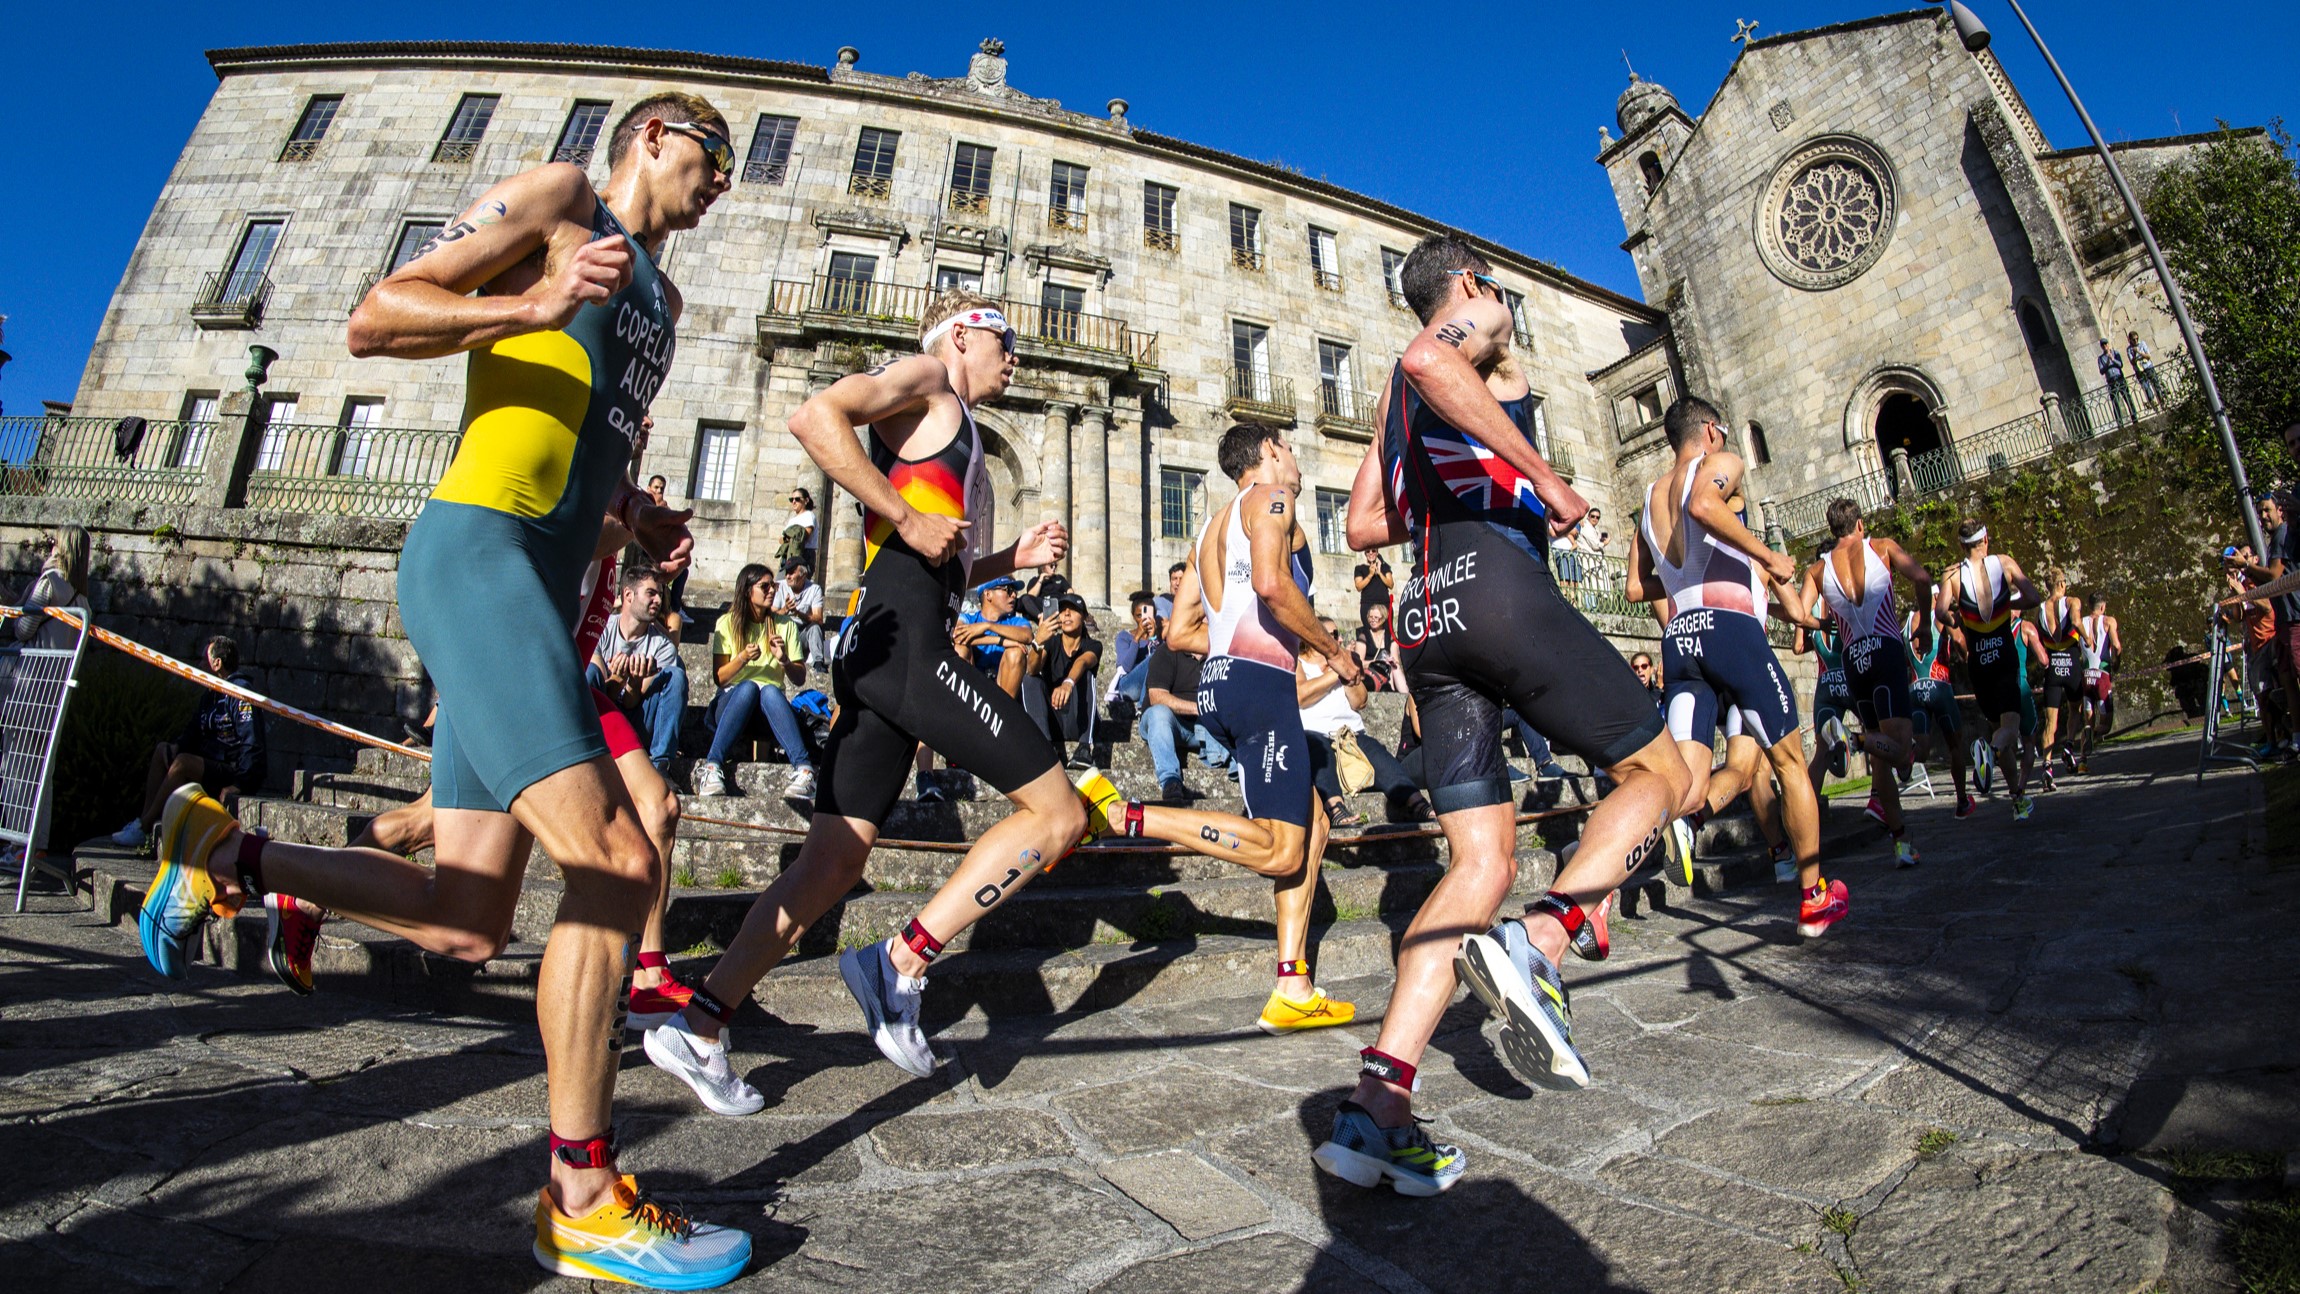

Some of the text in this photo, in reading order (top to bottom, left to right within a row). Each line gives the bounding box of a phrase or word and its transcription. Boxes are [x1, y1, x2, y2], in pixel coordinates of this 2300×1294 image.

[620, 357, 659, 410] AUS
[1269, 502, 1285, 514] 8
[1405, 598, 1467, 640] GBR
[1665, 610, 1715, 638] BERGERE
[1676, 637, 1703, 657] FRA
[1856, 655, 1872, 674] USA
[1980, 649, 2000, 665] GER
[2054, 667, 2071, 677] GER
[1767, 662, 1789, 714] cervélo
[1829, 684, 1849, 697] POR
[1917, 691, 1930, 701] POR
[936, 661, 1003, 738] CANYON
[1197, 688, 1218, 716] FRA
[1200, 824, 1220, 843] 8
